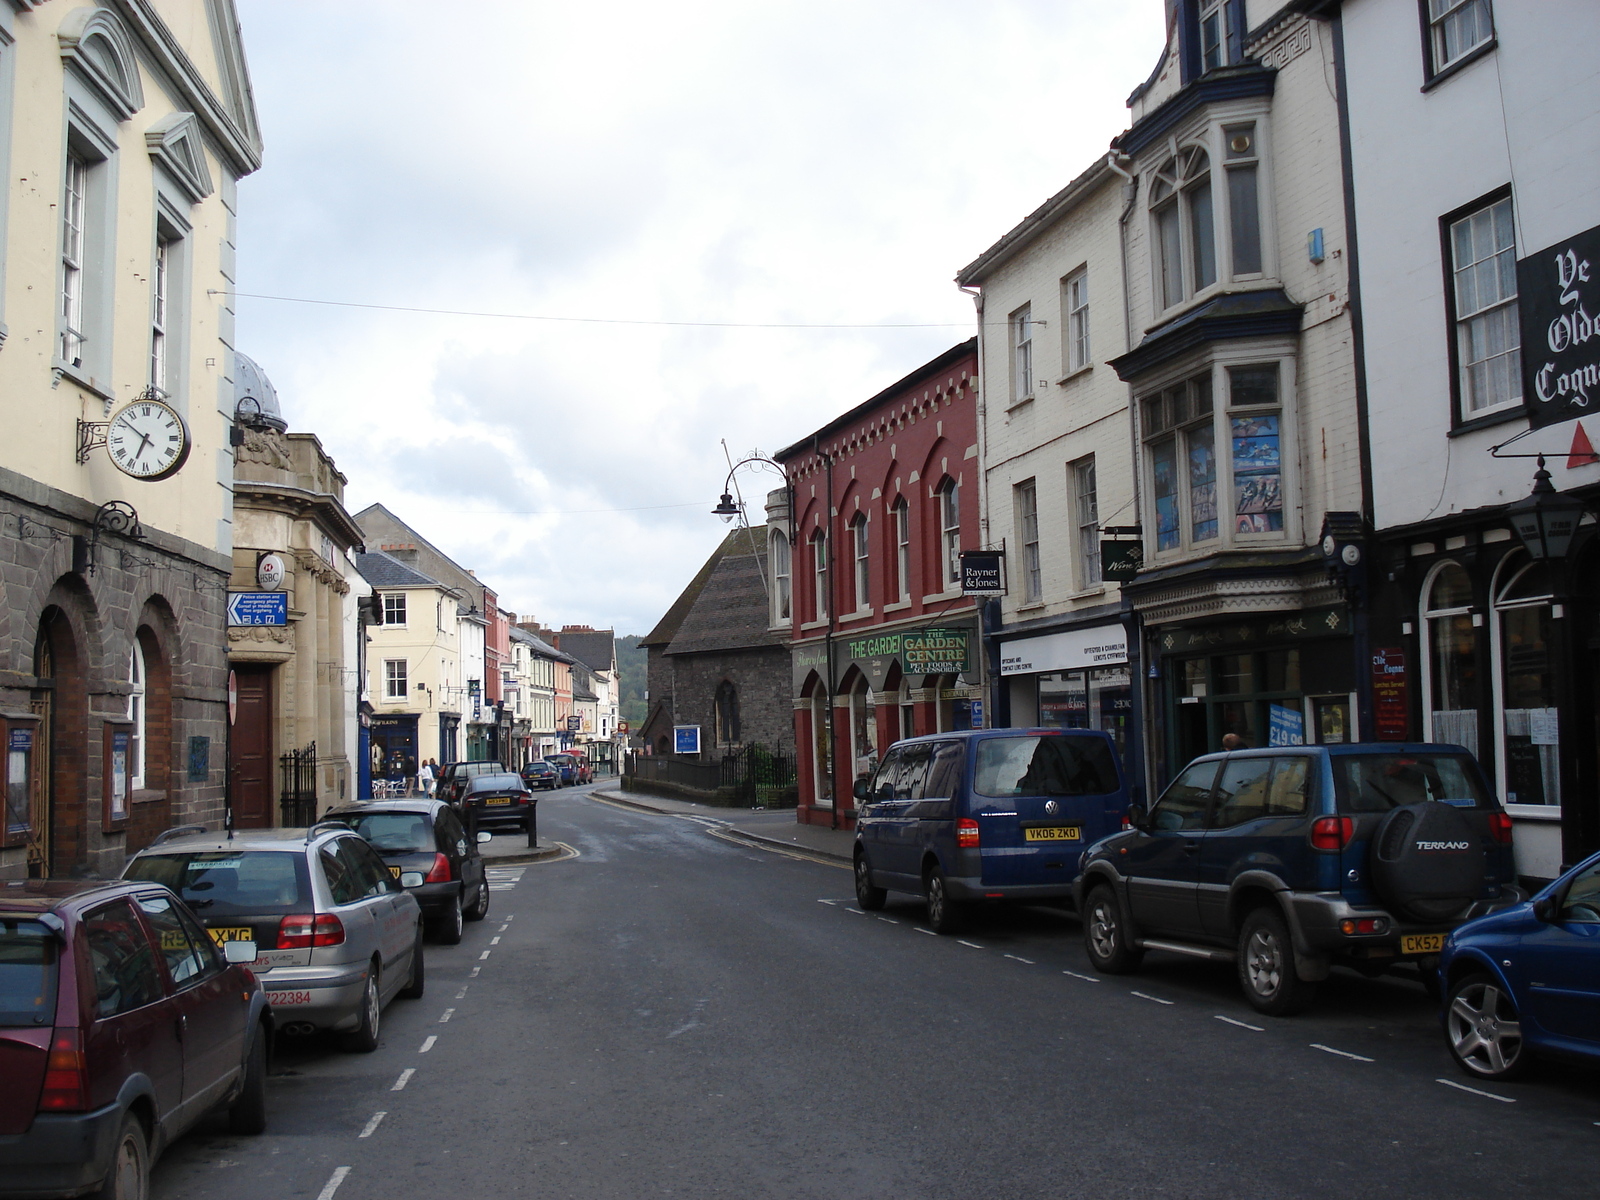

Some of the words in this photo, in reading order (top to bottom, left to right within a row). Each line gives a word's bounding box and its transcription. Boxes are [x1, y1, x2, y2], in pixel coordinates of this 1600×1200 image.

[1554, 248, 1590, 308] Ye
[1535, 361, 1600, 408] Cogn
[1108, 560, 1134, 572] Wine
[260, 573, 279, 583] HSBC
[966, 568, 998, 580] Rayner
[849, 641, 866, 659] THE
[904, 637, 966, 650] GARDEN
[906, 649, 965, 662] CENTRE
[1384, 664, 1405, 676] Cognac
[1029, 829, 1055, 839] VK06
[1058, 828, 1076, 838] ZKO
[1416, 841, 1469, 850] TERRANO
[215, 929, 250, 945] XWG
[1406, 936, 1440, 950] CK52
